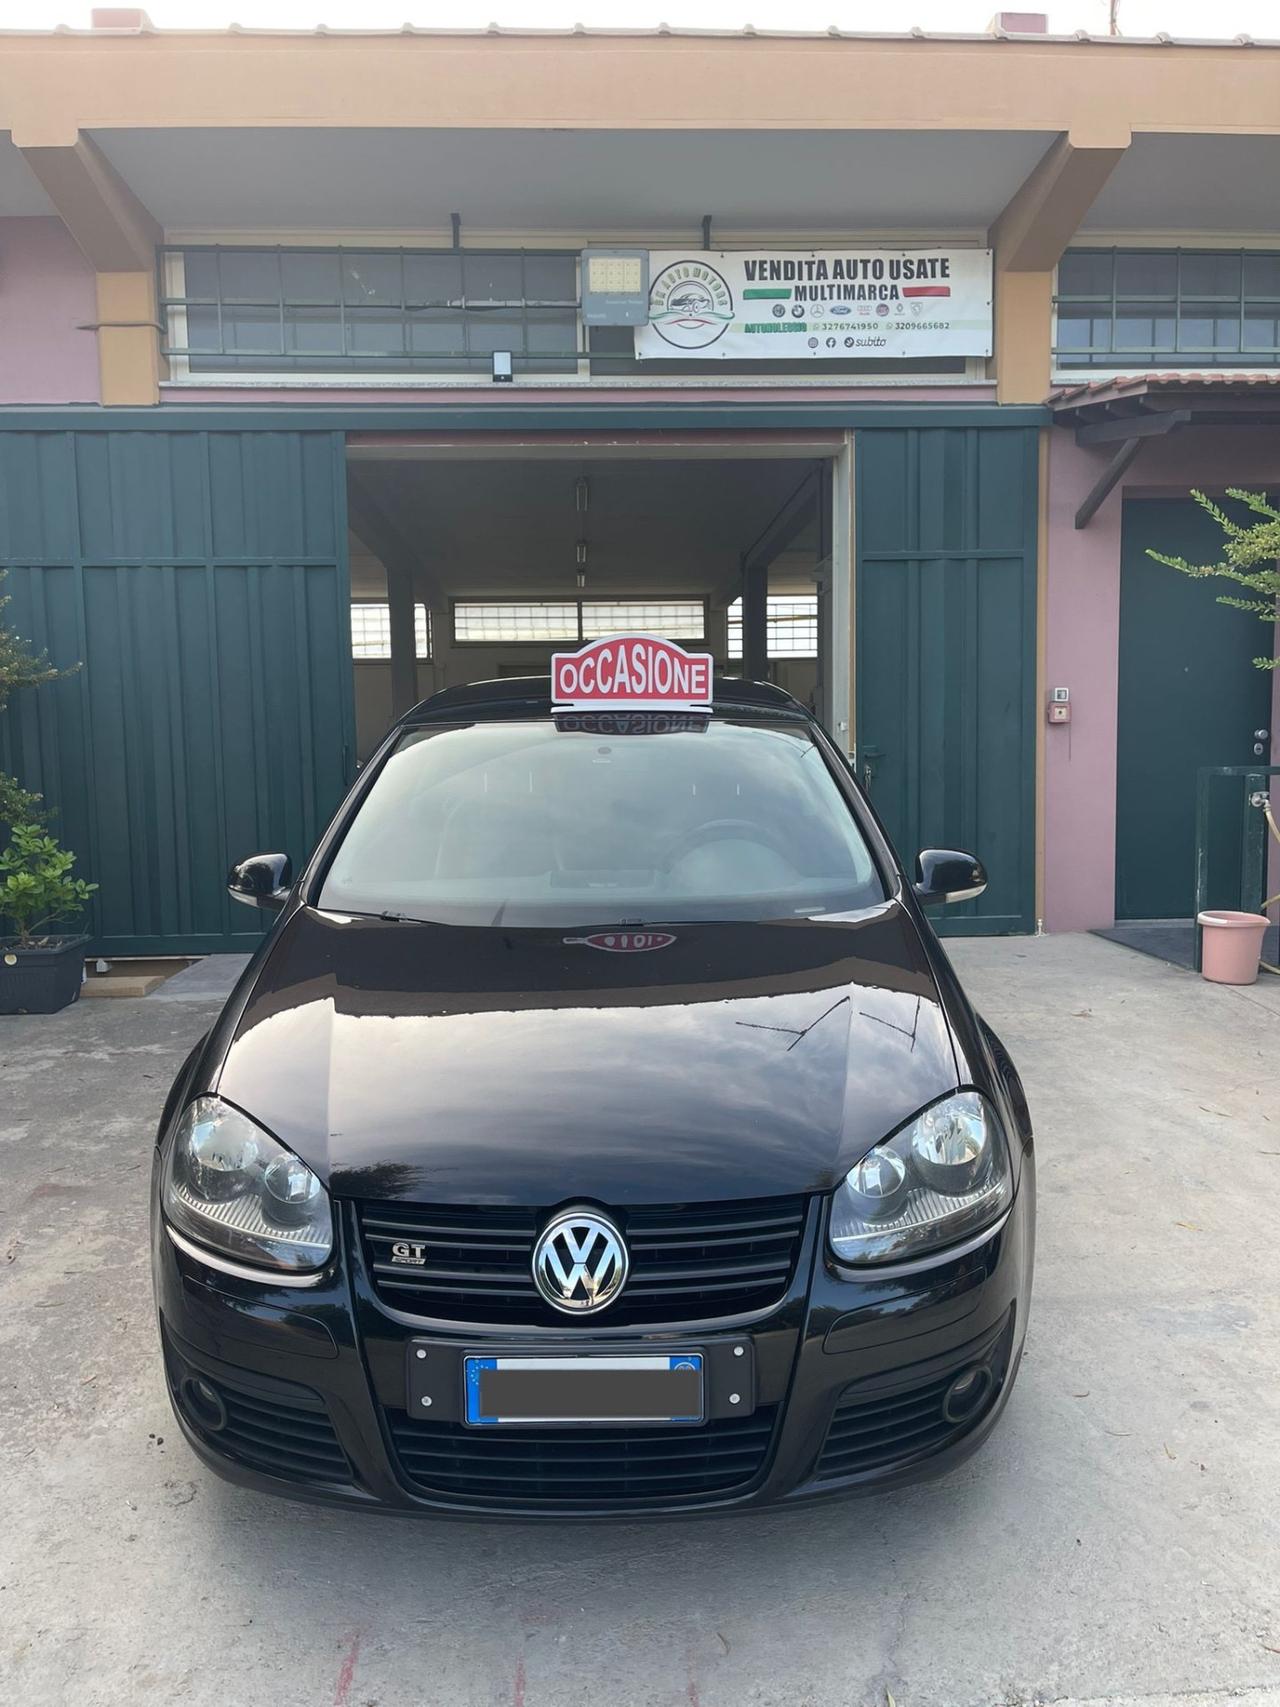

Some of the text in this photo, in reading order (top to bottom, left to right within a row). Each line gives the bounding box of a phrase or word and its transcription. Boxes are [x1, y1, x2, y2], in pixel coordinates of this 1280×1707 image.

[744, 257, 950, 281] VENDITA AUTO USATE
[794, 284, 900, 302] MULTIMARCA
[855, 335, 887, 347] subito
[559, 643, 706, 694] OCCASIONE
[392, 1242, 425, 1258] GT
